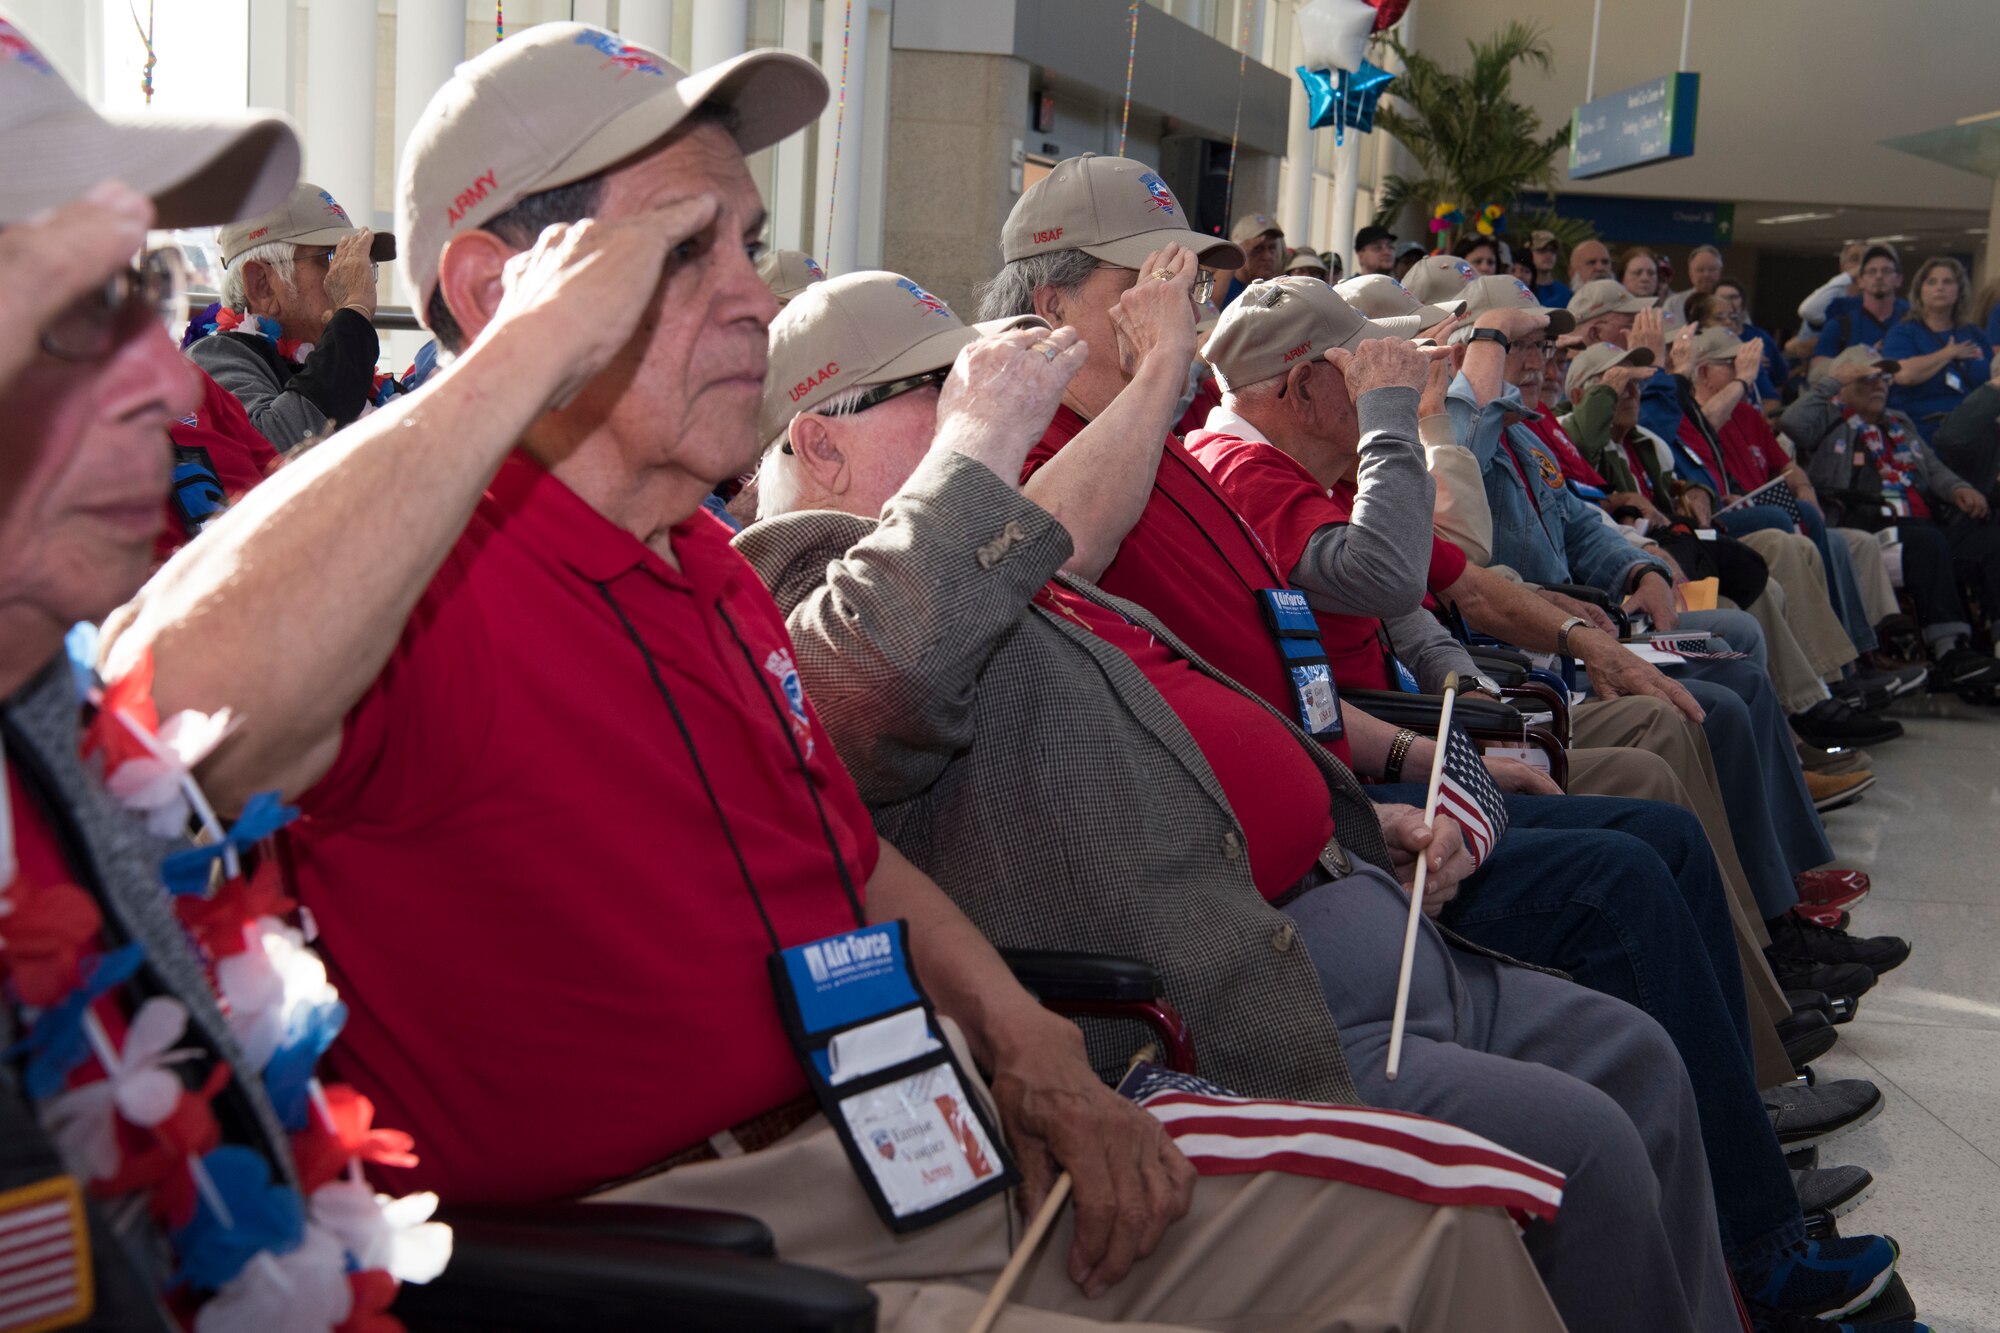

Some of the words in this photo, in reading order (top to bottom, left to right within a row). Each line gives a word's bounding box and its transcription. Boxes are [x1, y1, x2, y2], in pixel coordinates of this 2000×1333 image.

[447, 168, 498, 228] ARMY
[248, 227, 269, 240] ARMY
[1033, 227, 1063, 244] USAF
[1283, 340, 1312, 363] ARMY
[788, 362, 840, 402] USAAC
